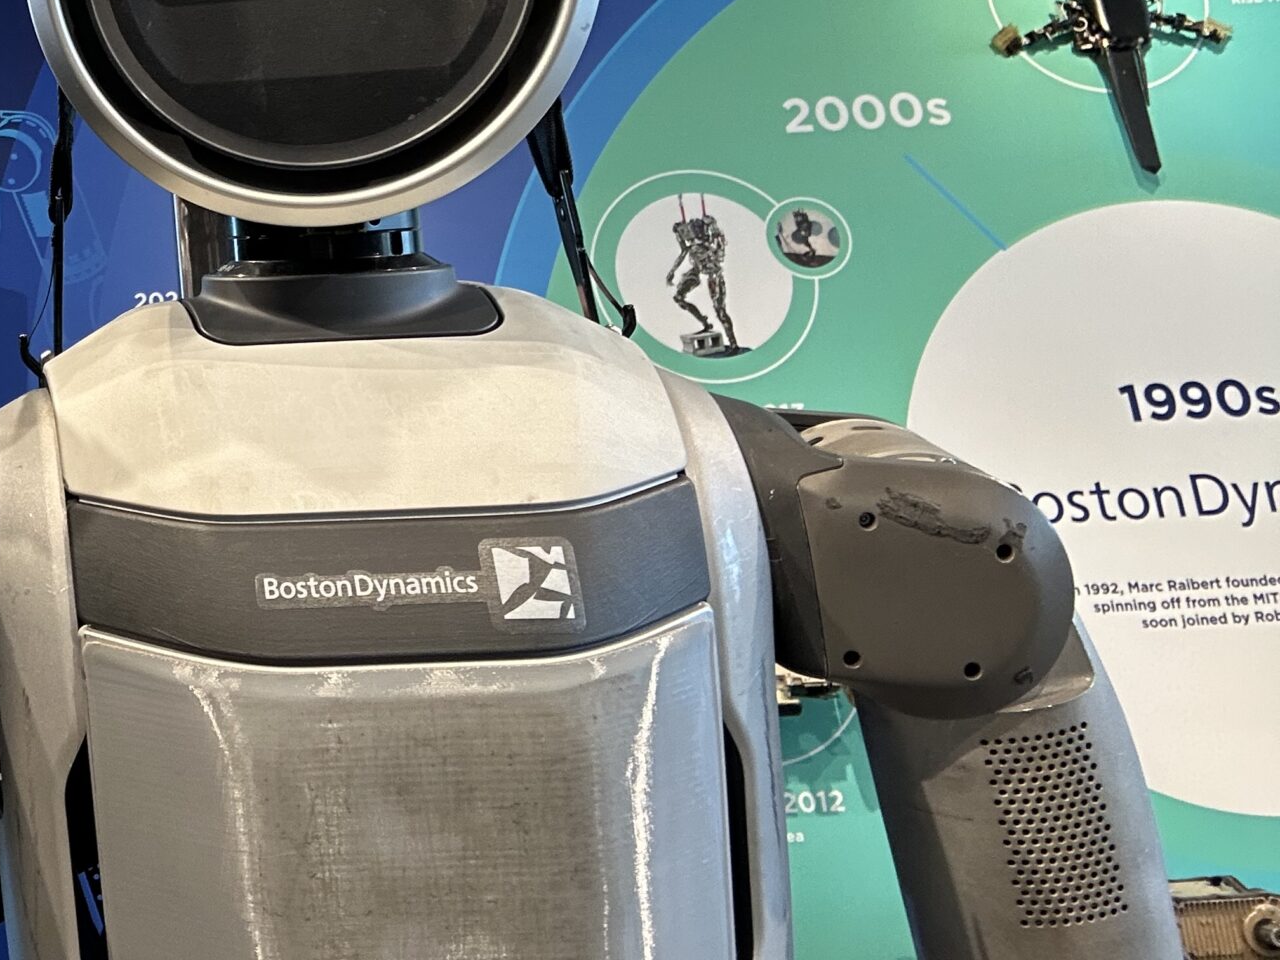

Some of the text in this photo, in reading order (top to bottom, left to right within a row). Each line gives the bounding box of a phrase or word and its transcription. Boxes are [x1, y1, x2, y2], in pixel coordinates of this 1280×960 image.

[782, 92, 952, 134] 2000s
[134, 291, 179, 309] 202
[1118, 378, 1280, 422] 1990s
[263, 570, 479, 601] BostonDynamics
[1084, 582, 1125, 596] 1992,
[1128, 582, 1164, 594] Marc
[1167, 578, 1221, 592] Raibert
[1094, 592, 1279, 614] spinning off from the MIT
[1142, 617, 1178, 629] soon
[1181, 612, 1228, 630] joined
[1232, 611, 1250, 626] by
[784, 790, 846, 814] 2012
